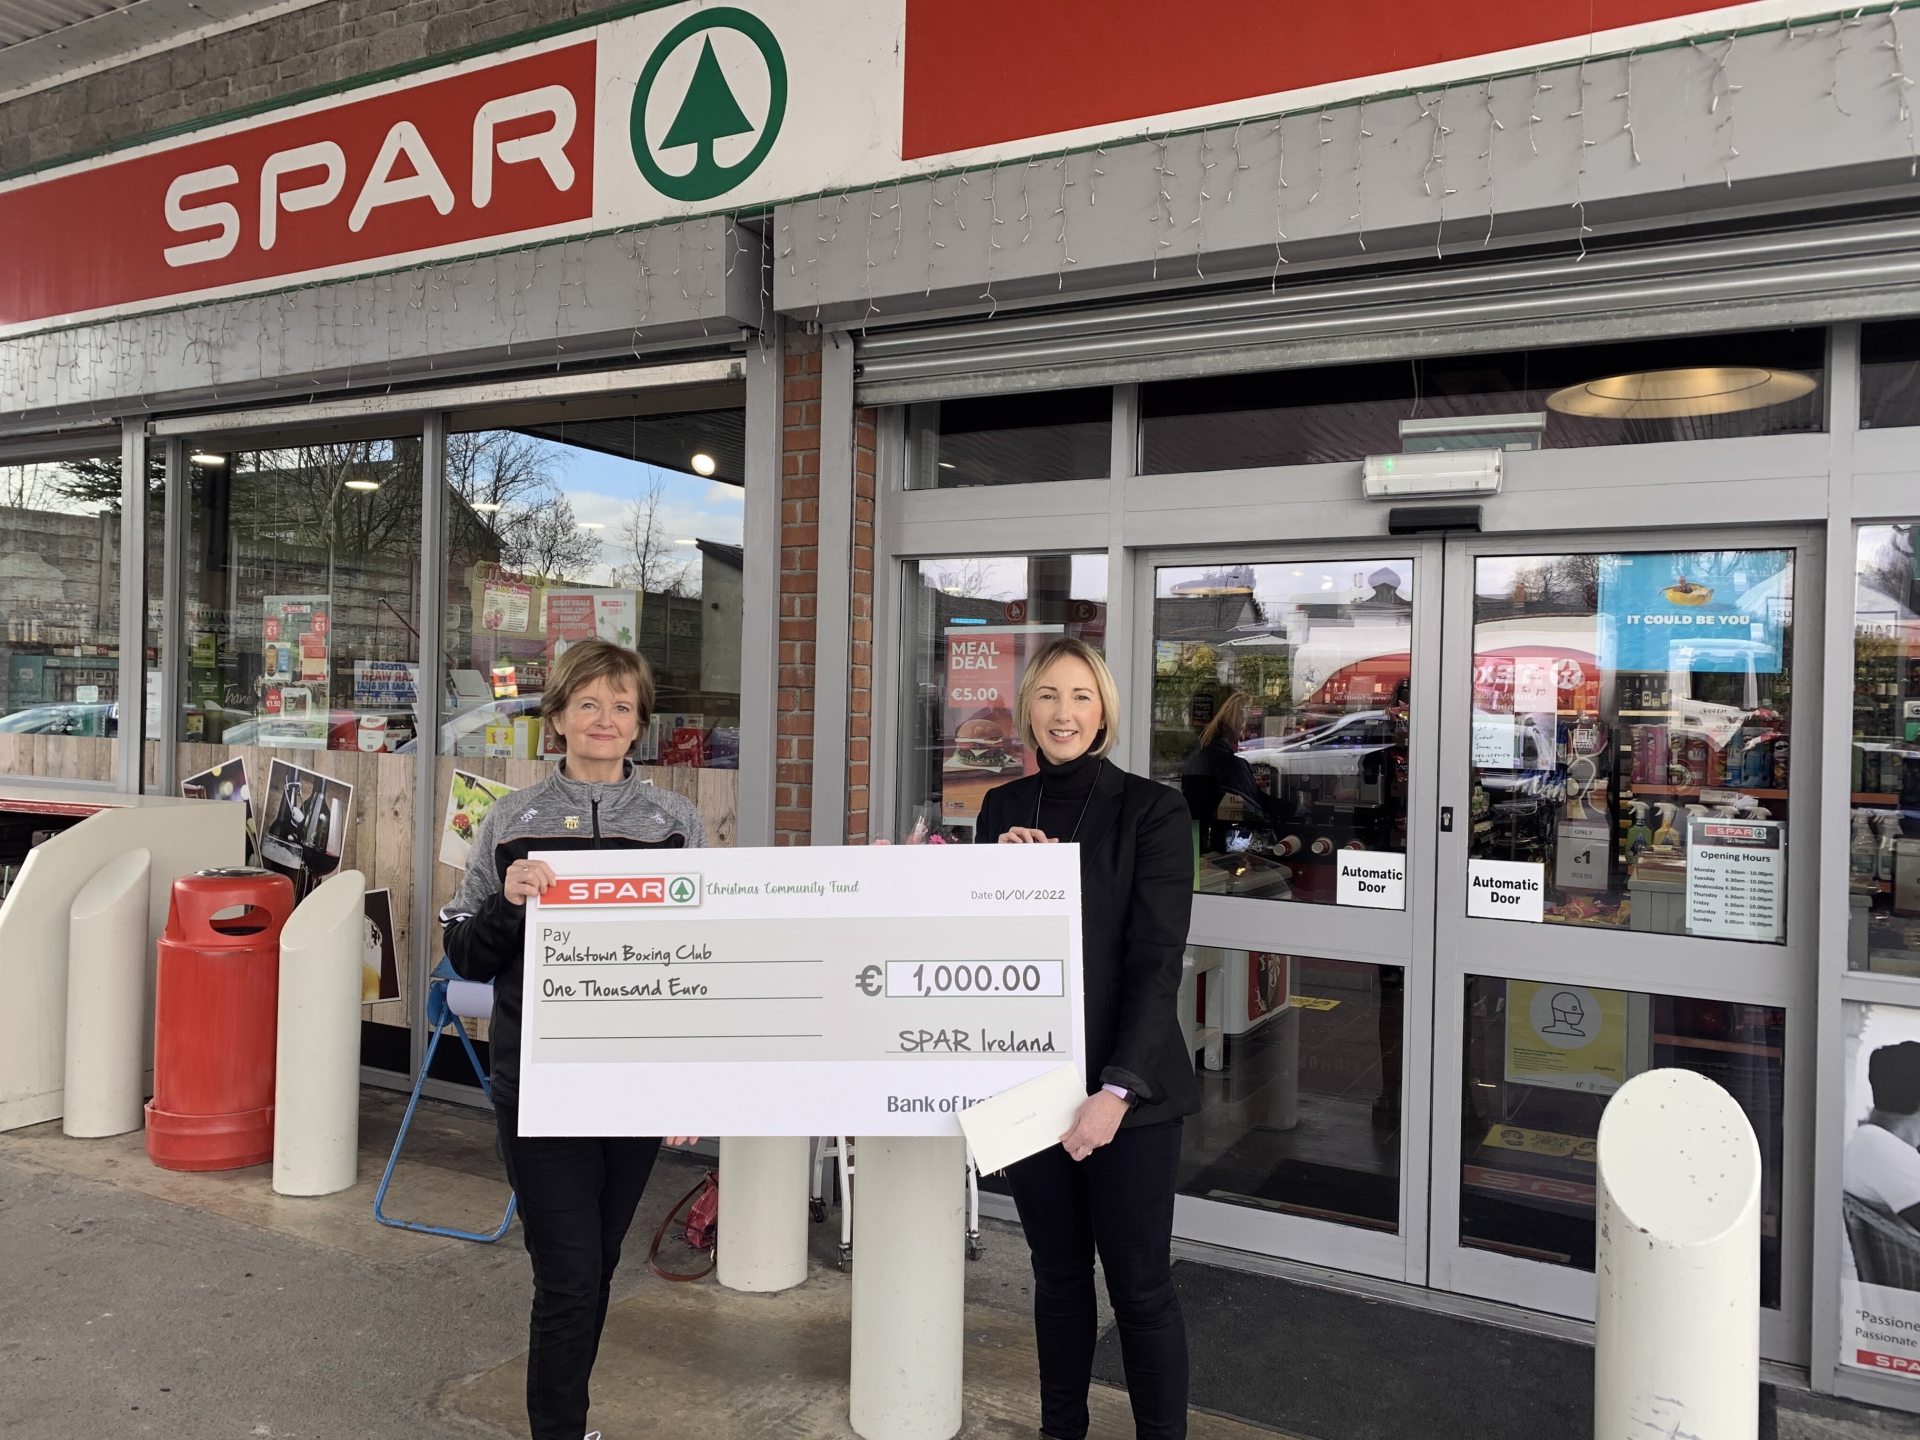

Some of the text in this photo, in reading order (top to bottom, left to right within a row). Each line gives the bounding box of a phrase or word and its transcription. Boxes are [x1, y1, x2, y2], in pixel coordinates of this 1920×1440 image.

[163, 84, 577, 268] SPAR
[315, 622, 325, 631] €1
[1627, 615, 1751, 625] IT COULD BE YOU
[267, 626, 277, 635] €1
[951, 641, 1000, 655] MEAL
[951, 656, 998, 670] DEAL
[951, 688, 998, 701] €5.00
[1716, 828, 1753, 836] SPAR
[1574, 850, 1591, 864] €1
[1700, 851, 1771, 862] Opening Hours
[1341, 865, 1404, 881] Automatic
[568, 881, 663, 900] SPAR
[705, 879, 860, 897] Christmas Community Fund
[1358, 880, 1386, 894] Door
[1472, 875, 1539, 891] Automatic
[971, 889, 1066, 901] Date 01/01/2022
[1490, 890, 1521, 905] Door
[543, 928, 571, 945] Pay
[544, 943, 713, 967] Paulstown Boxing Club
[543, 978, 708, 997] One Thousand Euro
[855, 963, 1041, 997] € 1,000.00
[899, 1029, 1055, 1053] SPAR Ireland
[887, 1096, 935, 1113] Bank
[938, 1095, 960, 1113] of
[1855, 1327, 1918, 1347] Passionate
